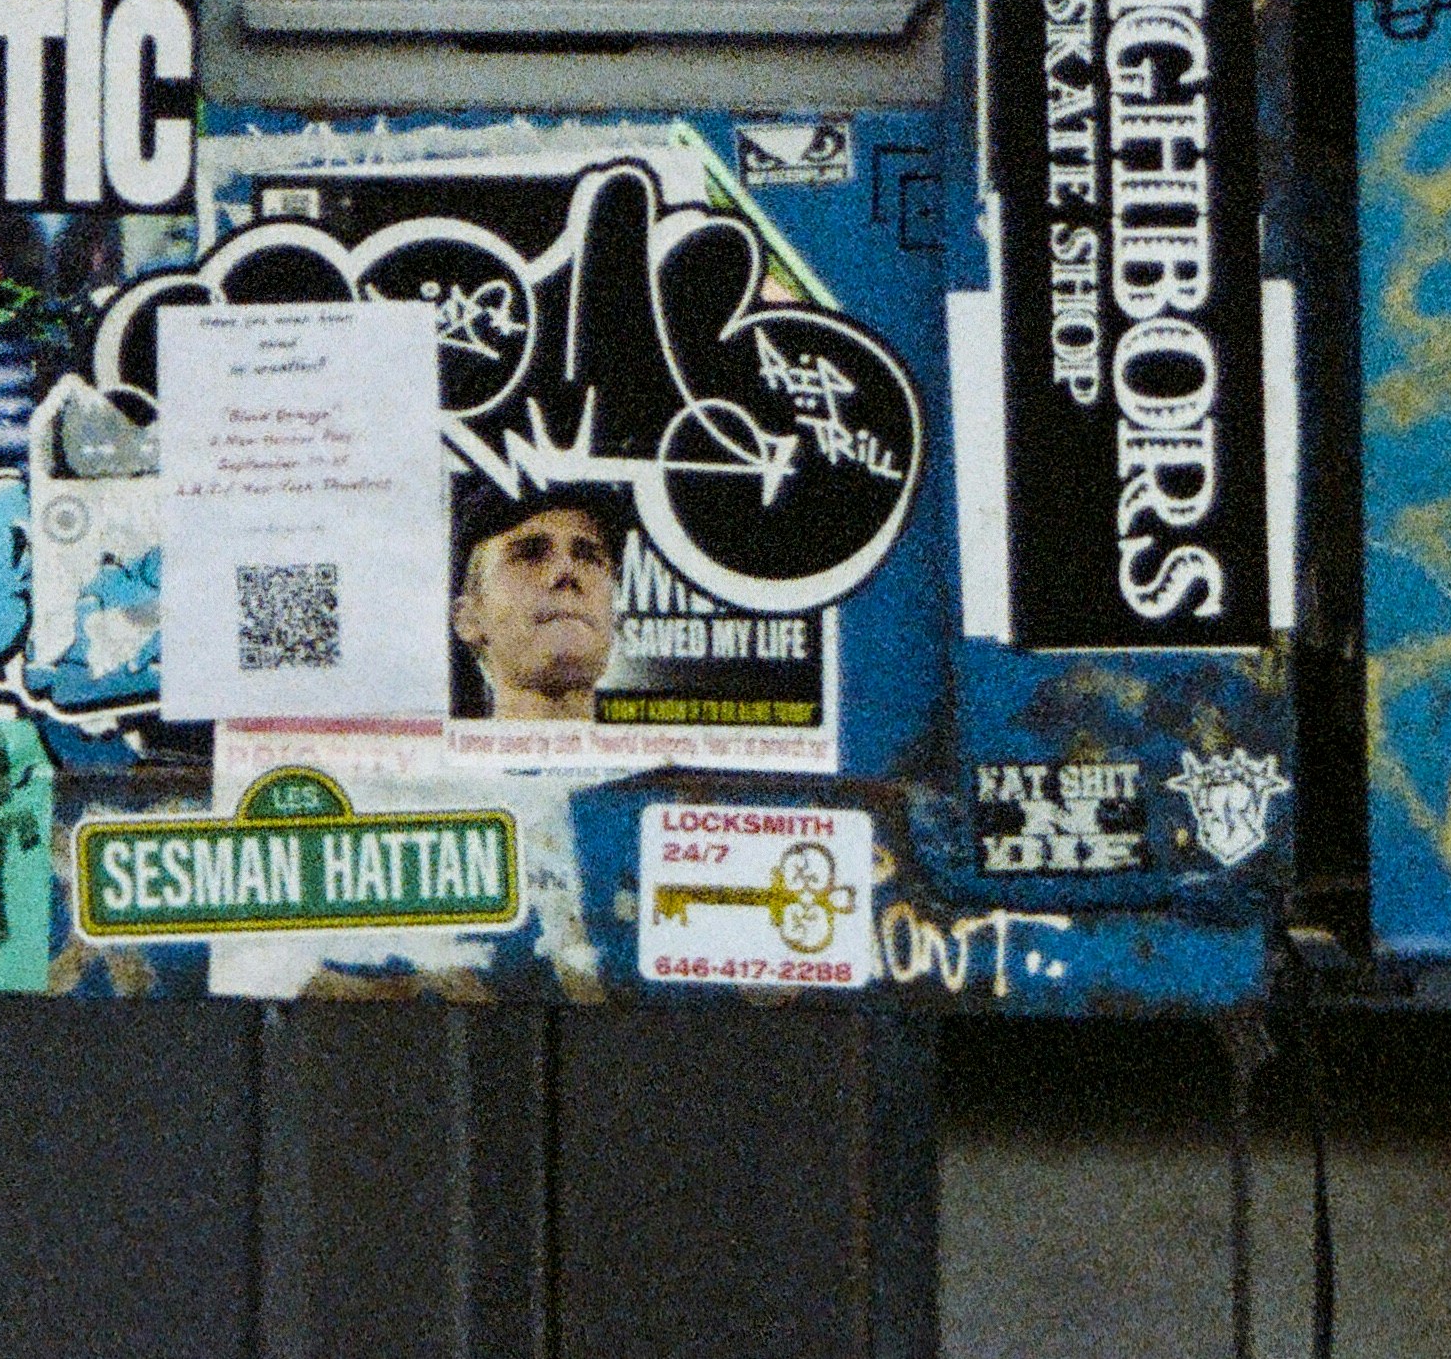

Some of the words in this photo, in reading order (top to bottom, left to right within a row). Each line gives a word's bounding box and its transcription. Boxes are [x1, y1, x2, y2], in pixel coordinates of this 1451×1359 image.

[1049, 219, 1105, 408] SHOP
[624, 619, 708, 659] SAVED
[712, 620, 754, 658] MY
[757, 620, 808, 659] LIFE
[661, 812, 837, 838] LOCKSMITH
[102, 837, 304, 912] SESMAN
[322, 828, 500, 904] HATTAN
[662, 842, 730, 867] 24/7
